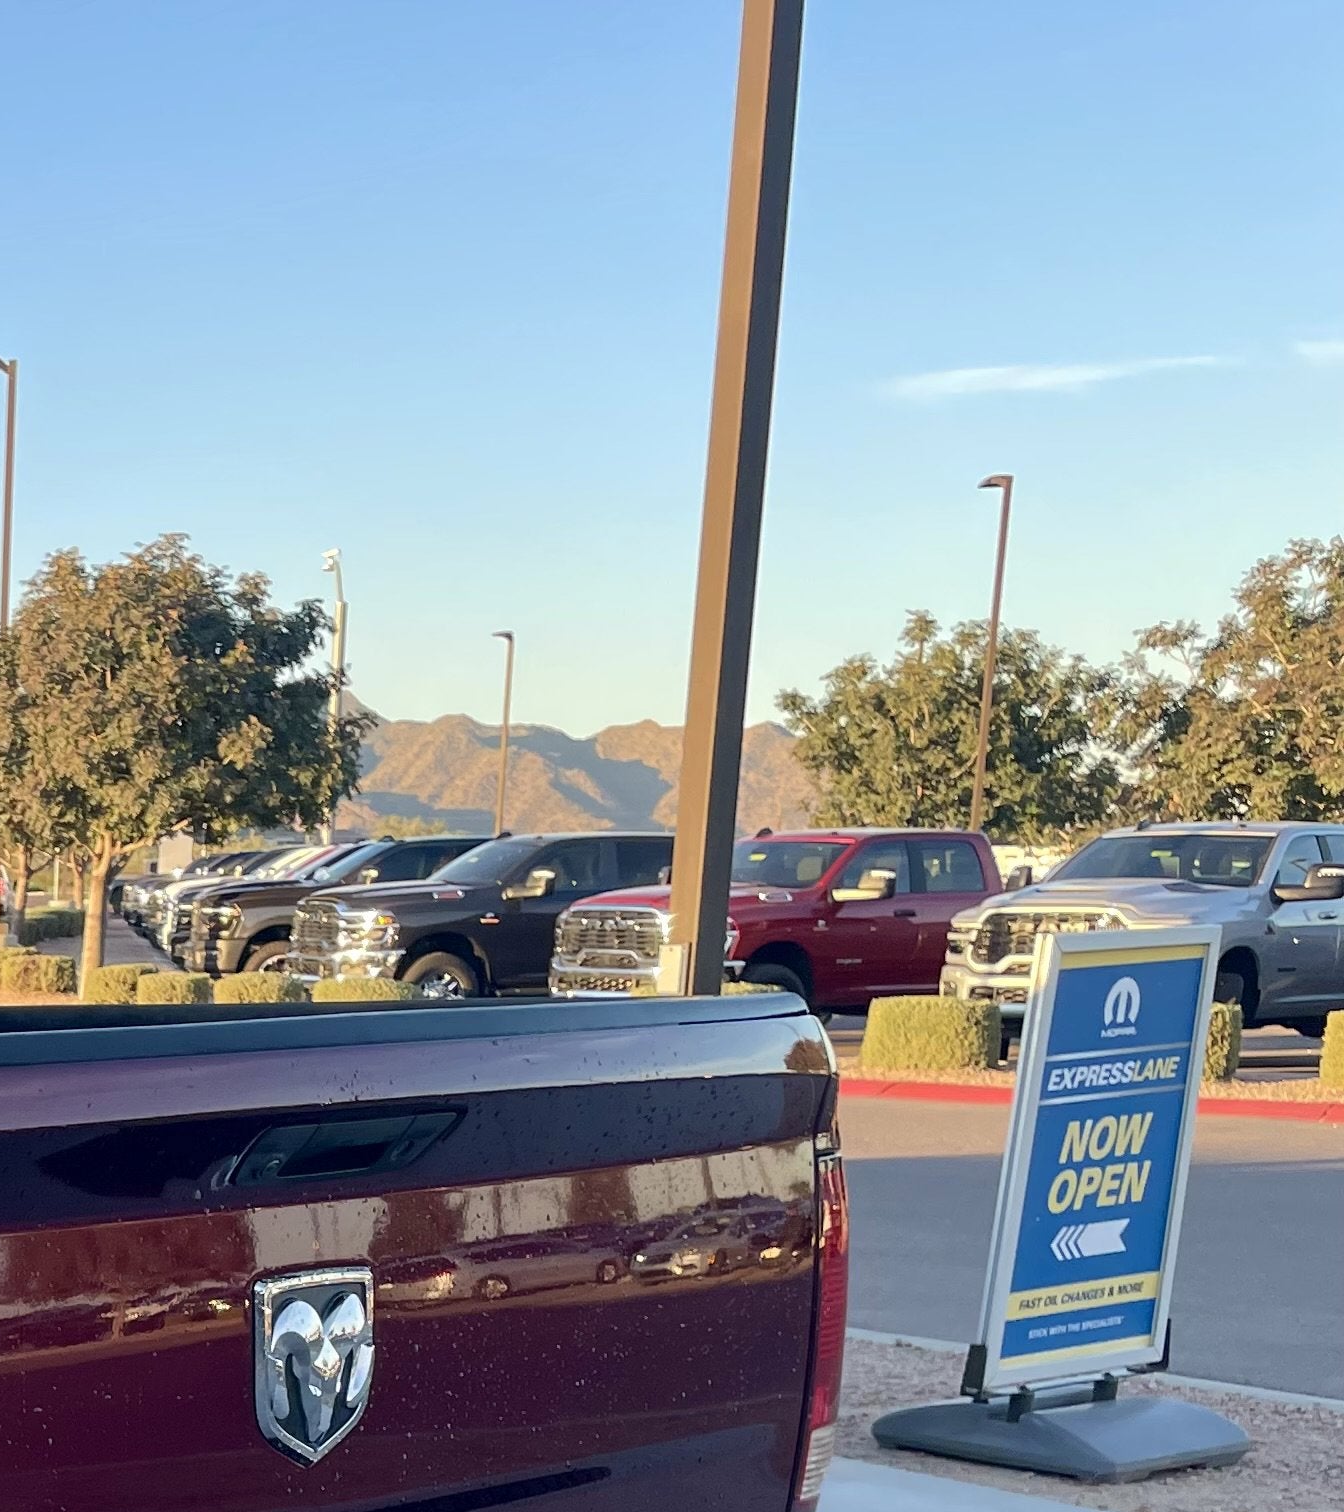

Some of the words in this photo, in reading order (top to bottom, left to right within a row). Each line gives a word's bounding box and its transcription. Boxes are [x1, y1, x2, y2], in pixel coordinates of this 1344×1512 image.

[1047, 1056, 1181, 1092] EXPRESSLANE
[1058, 1112, 1154, 1164] NOW
[1047, 1160, 1152, 1214] OPEN
[1018, 1297, 1043, 1311] FAST
[1060, 1287, 1106, 1304] CHANGES
[1107, 1286, 1114, 1297] &
[1117, 1281, 1144, 1295] MORE
